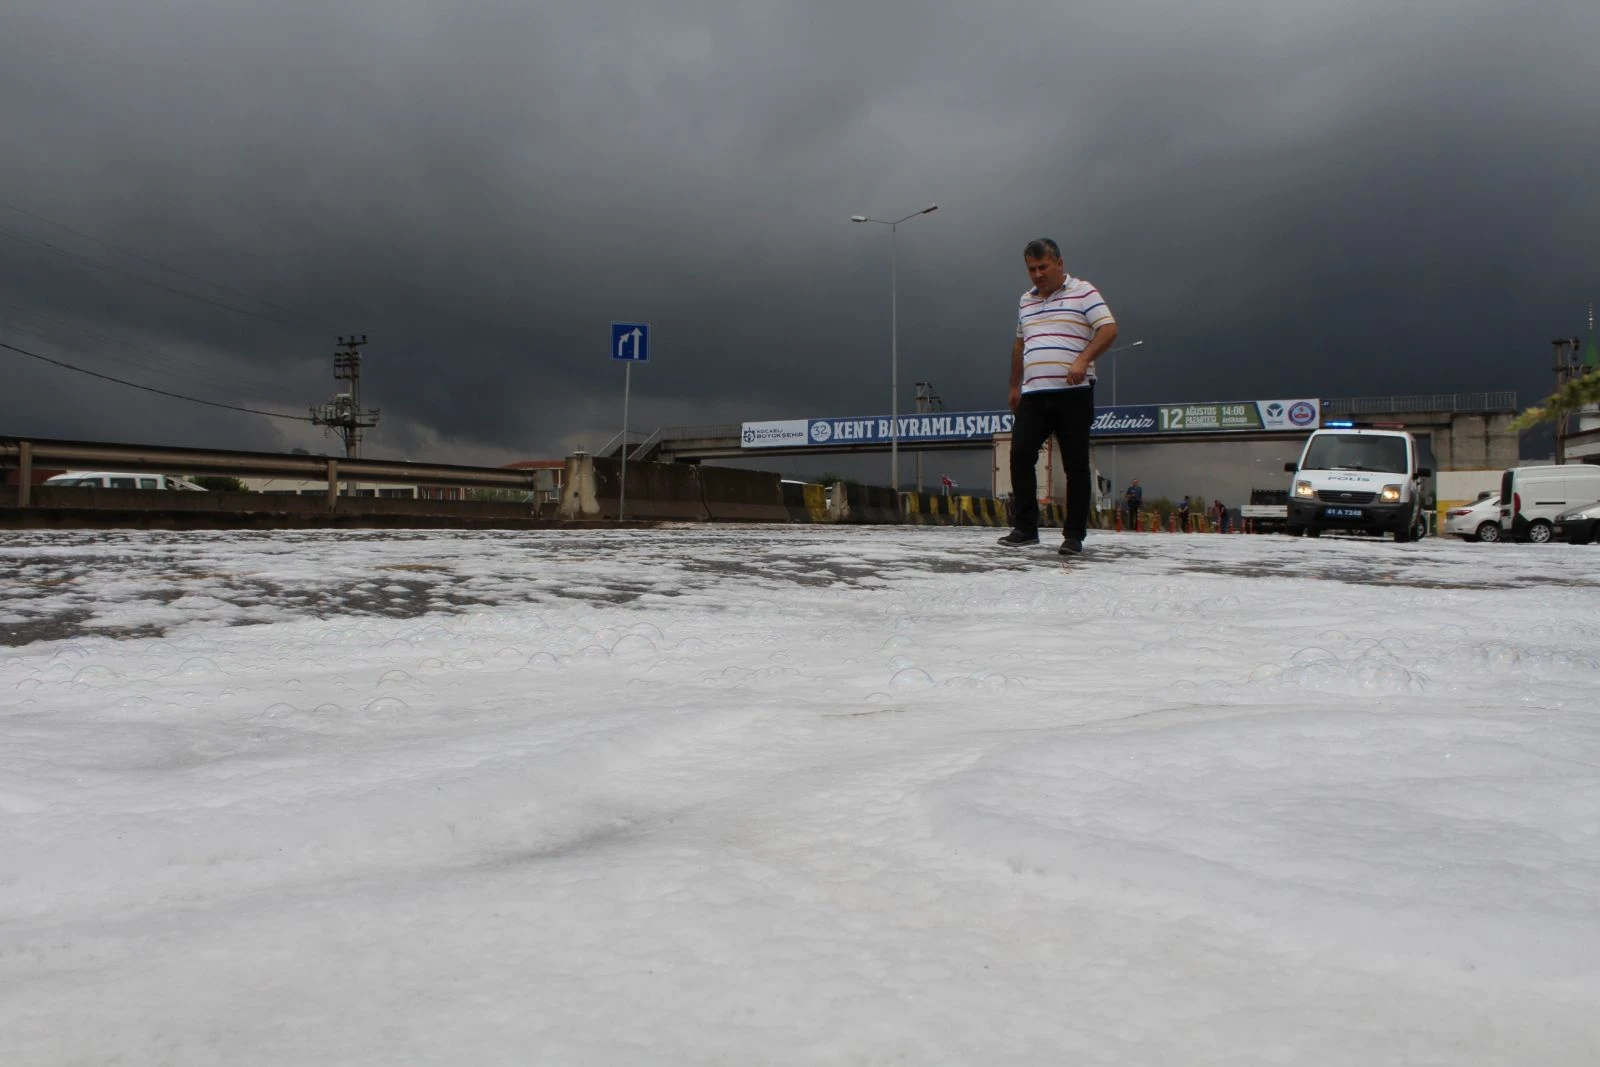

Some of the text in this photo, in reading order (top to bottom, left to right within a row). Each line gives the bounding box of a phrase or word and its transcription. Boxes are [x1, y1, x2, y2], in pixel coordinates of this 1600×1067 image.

[1161, 408, 1183, 428] 12
[1222, 405, 1245, 415] 14:00
[834, 420, 874, 439] KENT
[878, 414, 1015, 437] BAYRAMLAŞMAS
